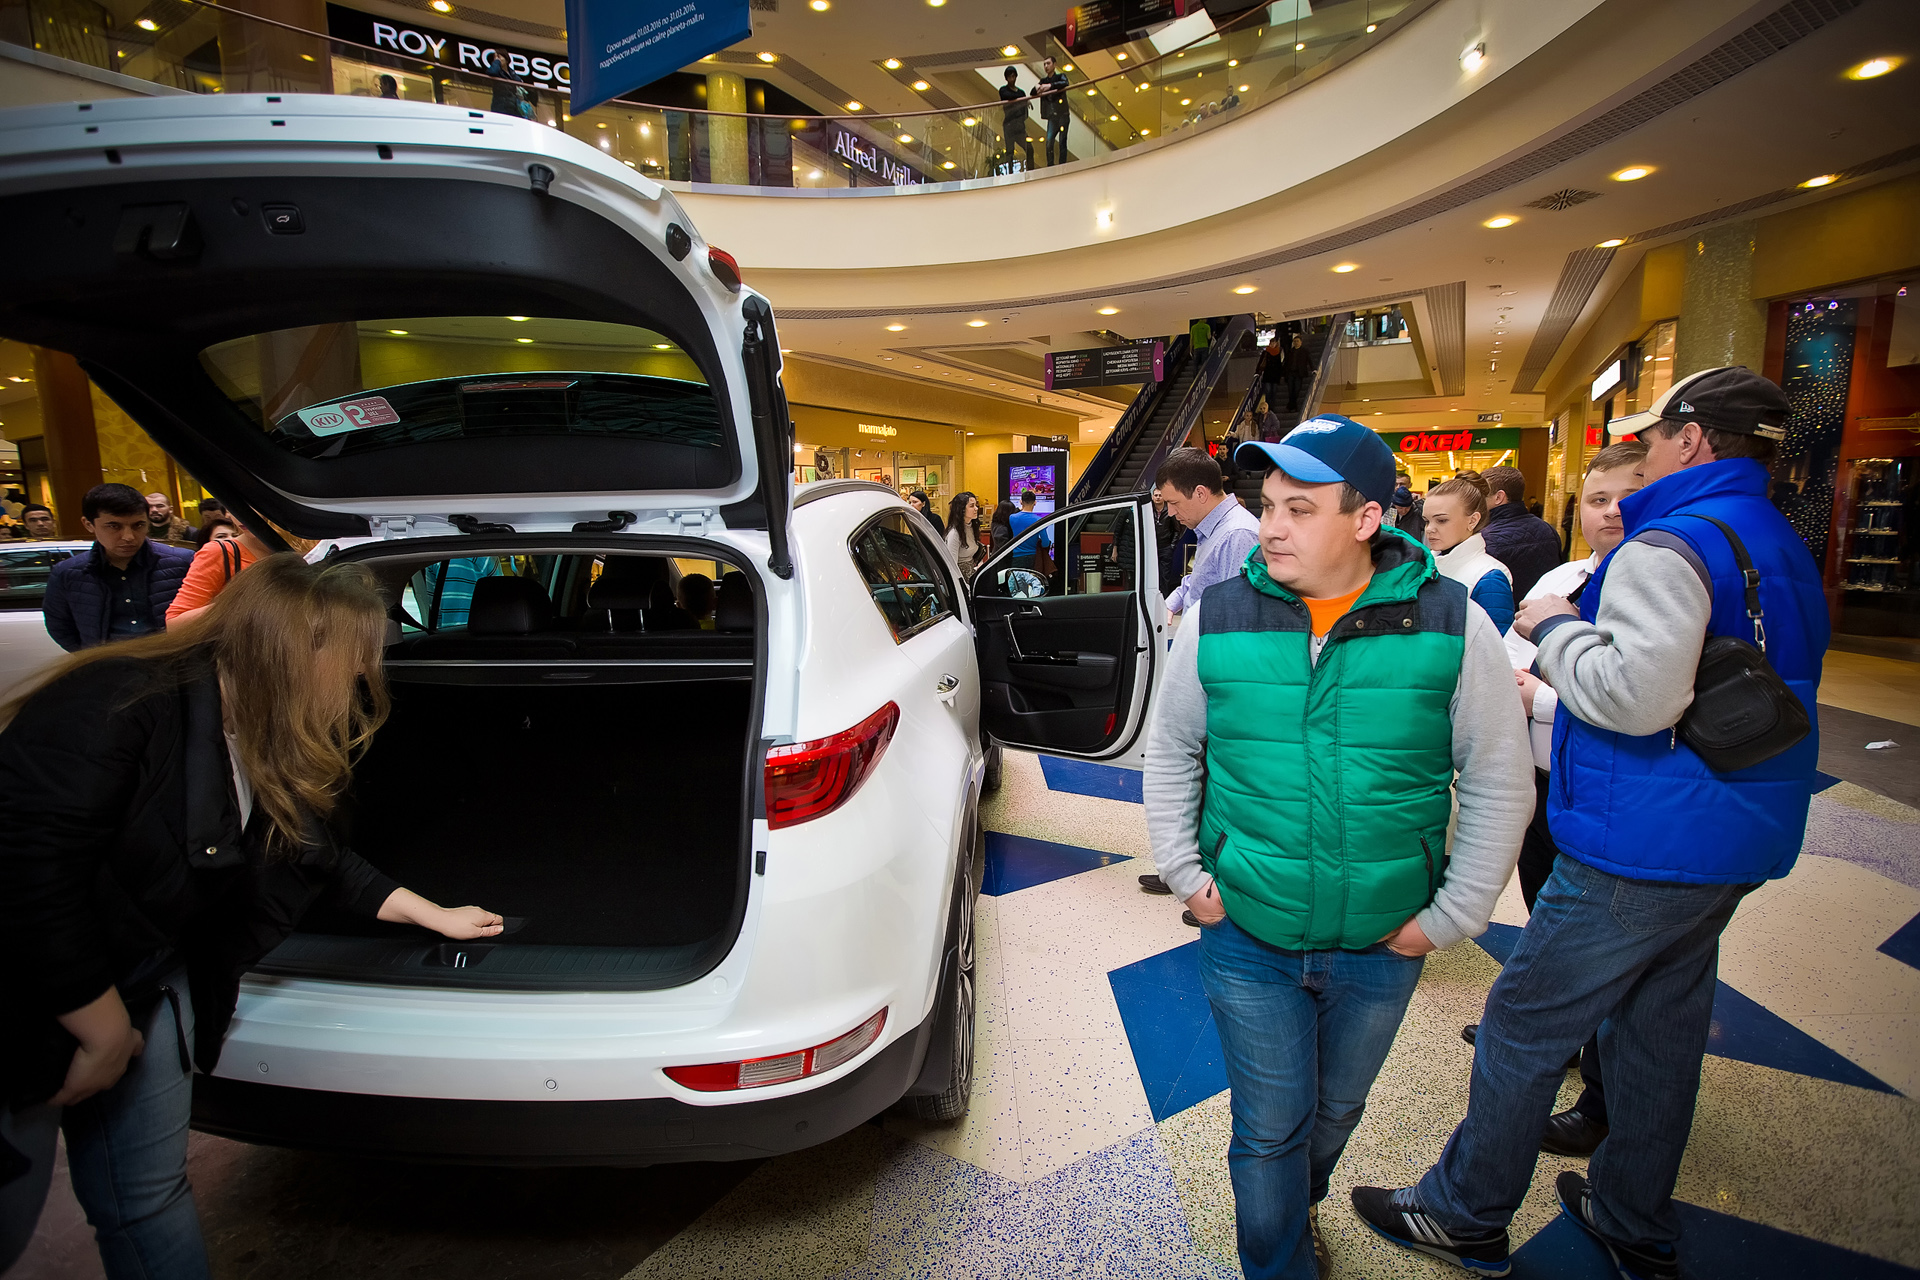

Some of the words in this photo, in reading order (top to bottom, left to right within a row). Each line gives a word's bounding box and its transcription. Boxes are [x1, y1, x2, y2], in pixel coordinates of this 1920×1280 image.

[373, 22, 446, 59] ROY
[599, 49, 631, 69] подробности
[666, 13, 705, 38] planeta-mall.ru
[637, 19, 662, 38] 01.03.2016
[834, 131, 878, 174] Alfred
